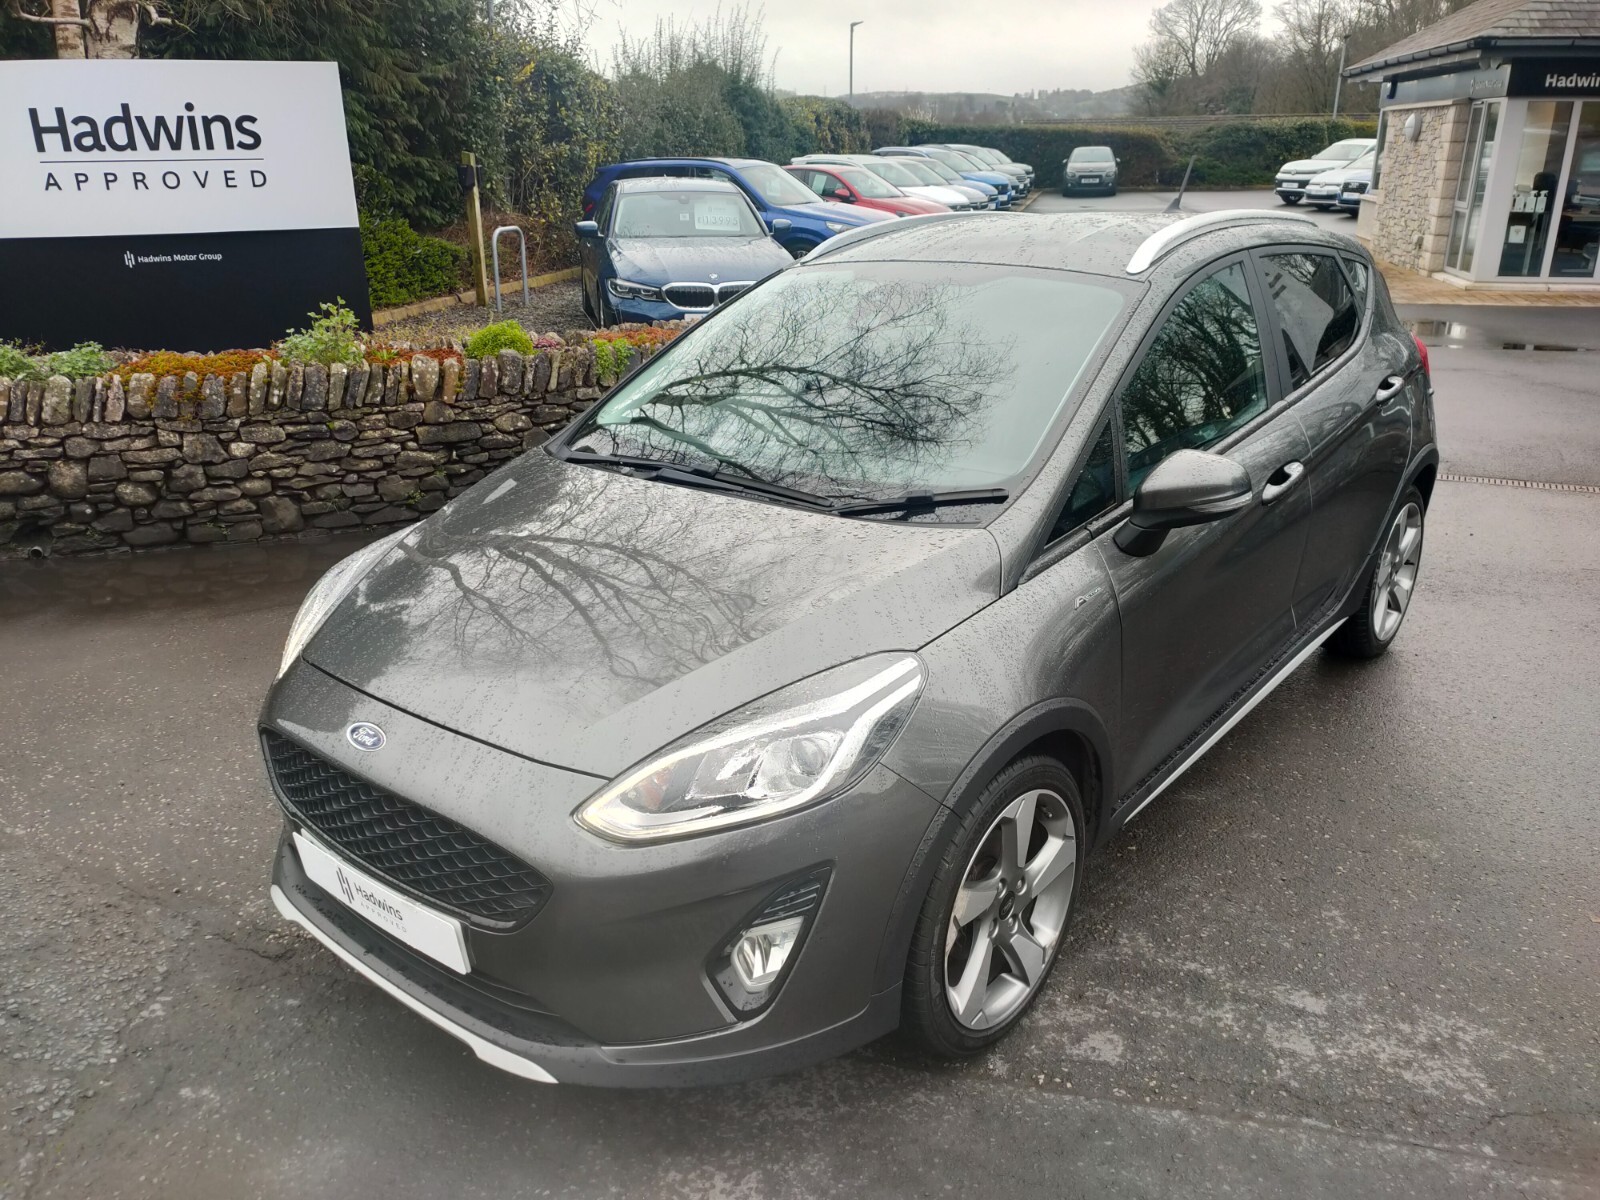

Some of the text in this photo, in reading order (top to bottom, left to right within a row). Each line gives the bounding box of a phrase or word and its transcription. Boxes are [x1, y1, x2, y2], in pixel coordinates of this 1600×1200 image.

[28, 102, 262, 152] Hadwins
[44, 169, 268, 191] APPROVED
[137, 255, 172, 263] Hadwins
[198, 253, 223, 261] Group
[353, 727, 378, 745] Ford
[353, 882, 404, 921] Hadwins
